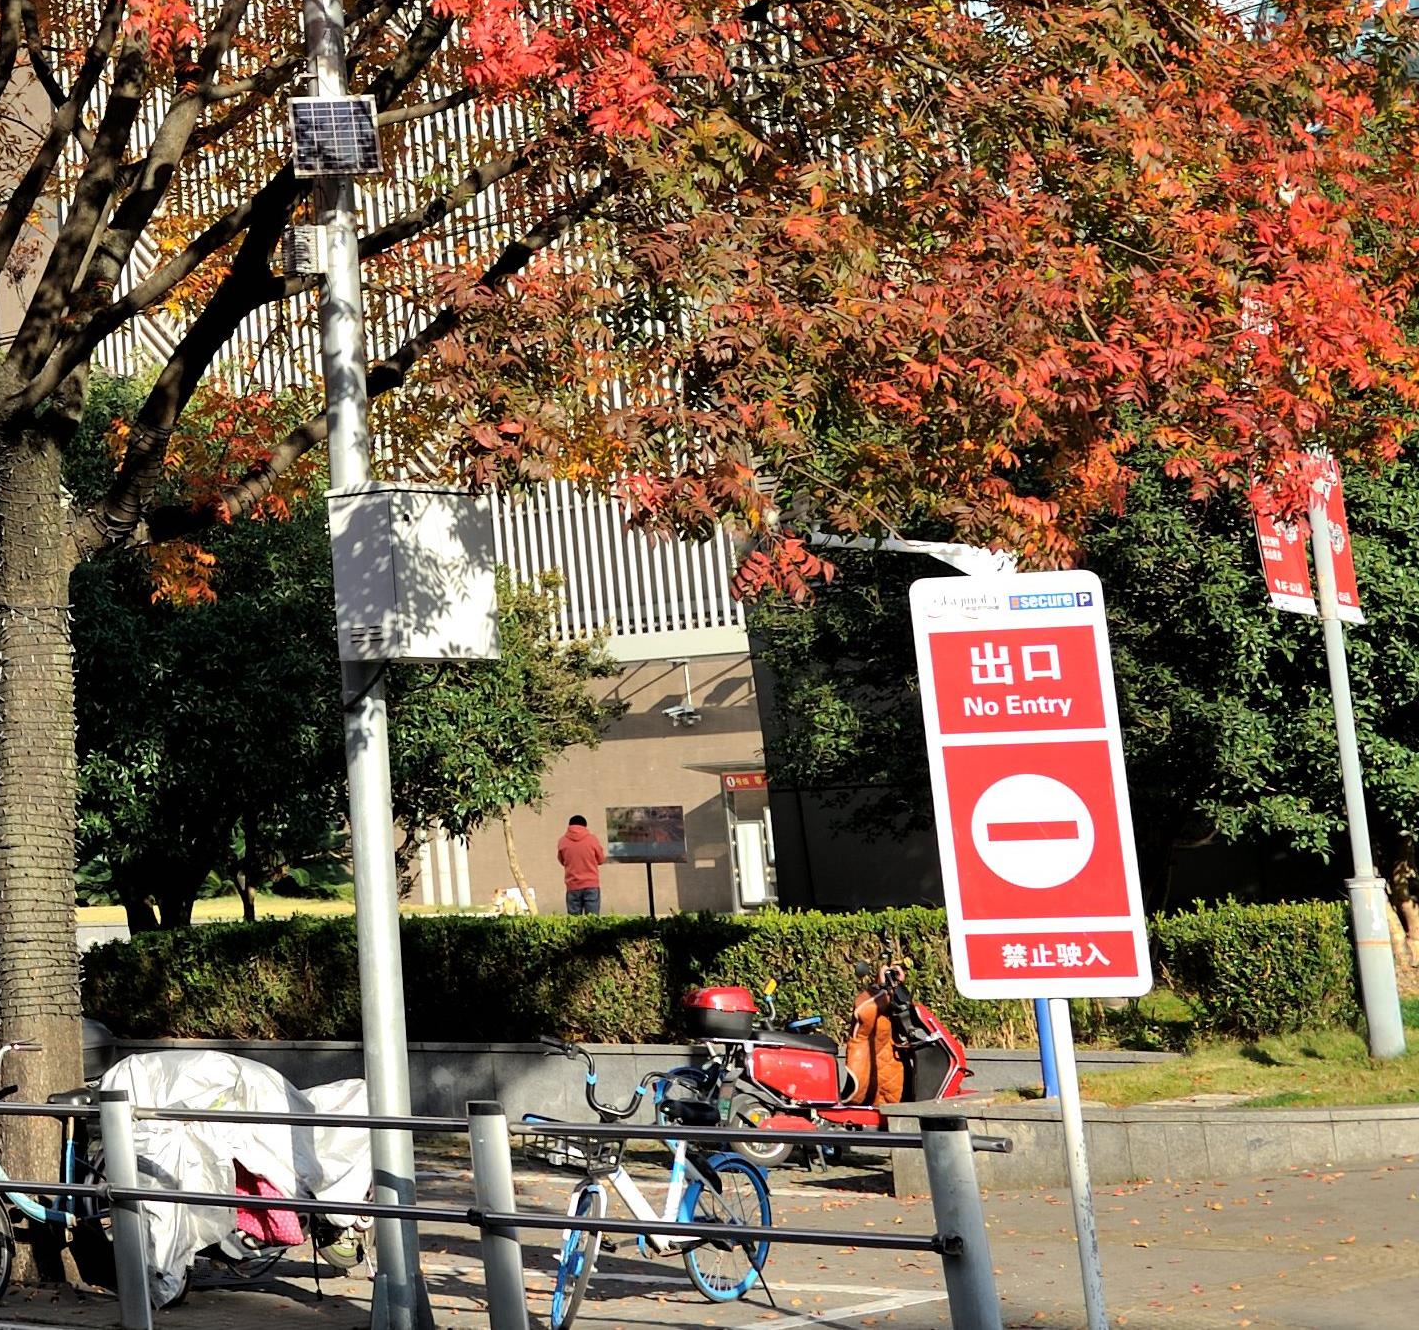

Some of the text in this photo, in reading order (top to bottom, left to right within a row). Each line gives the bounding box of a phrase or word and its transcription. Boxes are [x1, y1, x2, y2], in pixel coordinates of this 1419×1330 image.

[970, 642, 1062, 686] 出口
[964, 694, 1072, 718] No Entry
[1001, 942, 1111, 970] 禁止驶入
